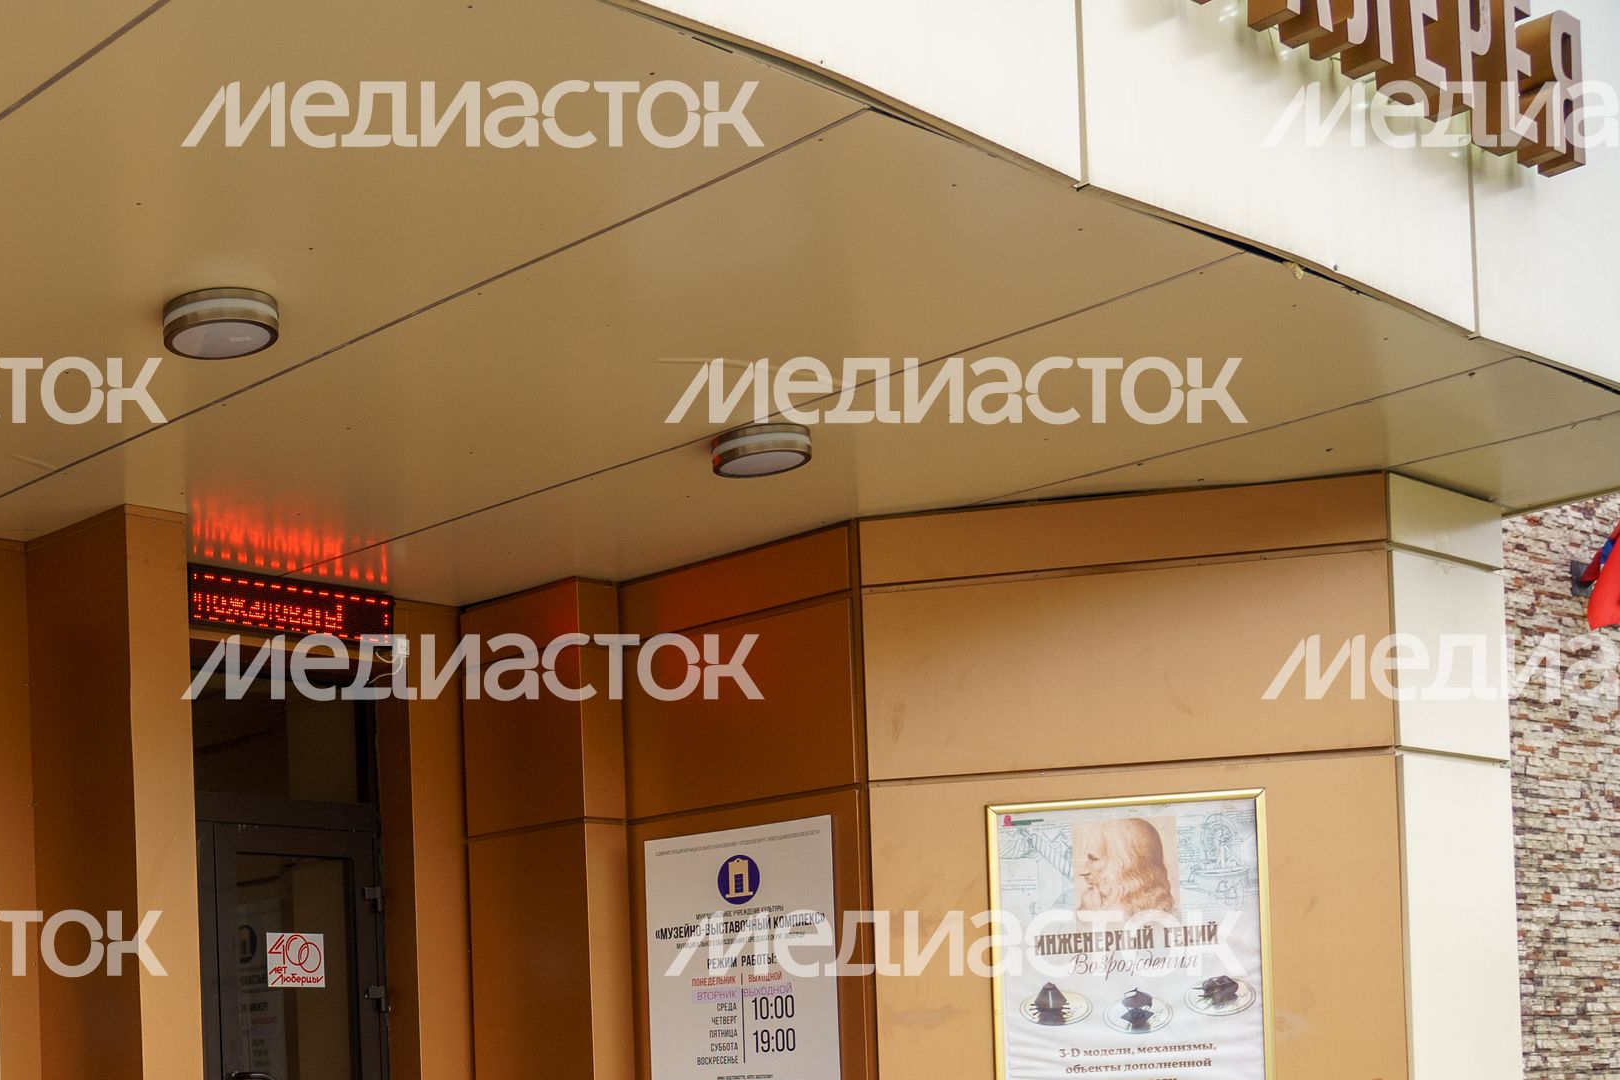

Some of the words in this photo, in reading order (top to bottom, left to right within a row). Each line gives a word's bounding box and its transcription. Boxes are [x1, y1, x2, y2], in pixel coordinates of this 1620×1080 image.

[1034, 925, 1155, 956] ИНЖЕНЕРНЫЙ
[1163, 921, 1219, 949] ГЕНИЙ
[707, 956, 737, 969] РЕЖИМ
[741, 953, 777, 967] РАБОТЫ:
[269, 965, 288, 975] лет
[692, 975, 736, 987] ПОНЕДЕЛЬНИК
[748, 971, 782, 983] ВЫХОДНОЙ
[697, 990, 737, 1001] ВТОРНИК
[744, 983, 793, 997] ВЫХОДНОЙ
[716, 1002, 737, 1012] СРЕДА
[751, 994, 795, 1020] 10:00
[711, 1015, 737, 1025] ЧЕТВЕРГ
[709, 1029, 738, 1039] ПЯТНИЦА
[752, 1028, 796, 1053] 19:00
[710, 1042, 739, 1052] СУББОТА
[1059, 1047, 1081, 1058] 3-D
[1083, 1046, 1135, 1057] модели,
[1137, 1042, 1217, 1054] механизмы,
[697, 1055, 739, 1066] ВОСКРЕСЕНЬЕ
[1065, 1063, 1121, 1074] объекты
[1124, 1058, 1212, 1072] дополненной
